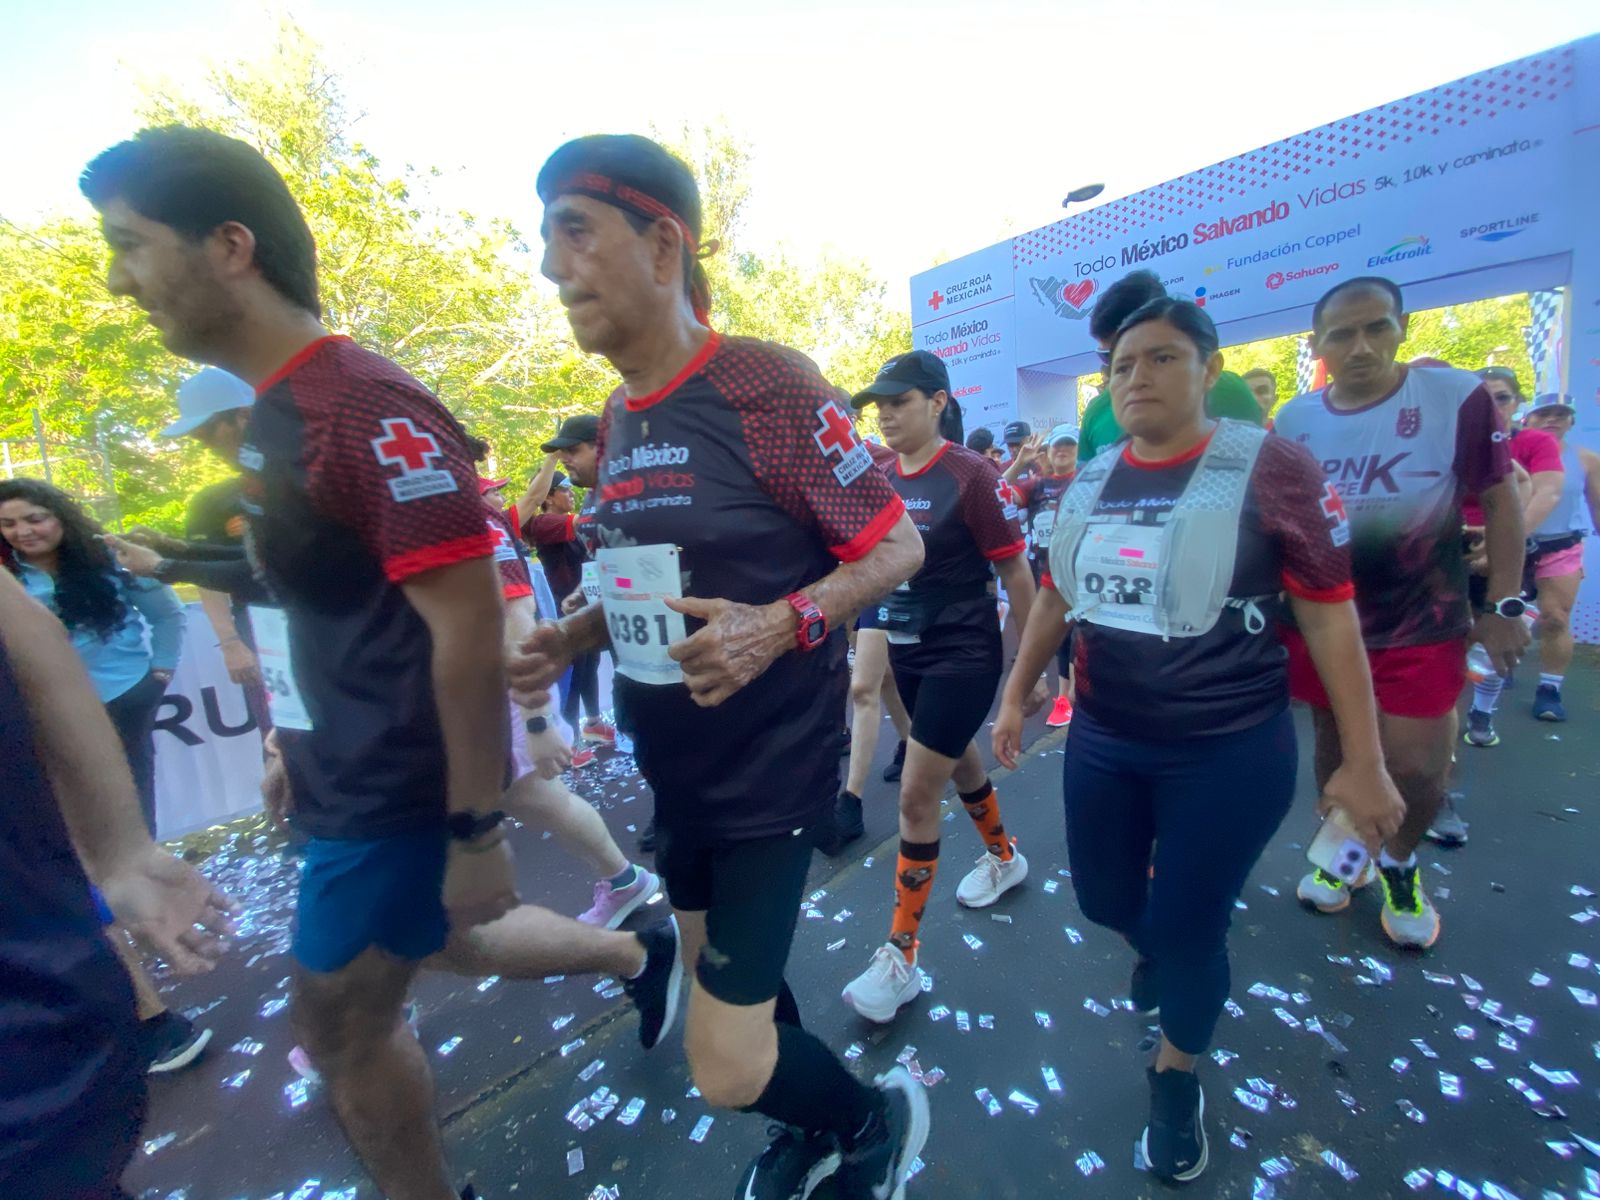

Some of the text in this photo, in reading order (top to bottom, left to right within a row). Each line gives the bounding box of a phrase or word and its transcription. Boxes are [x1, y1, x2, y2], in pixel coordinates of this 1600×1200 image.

[1074, 255, 1116, 277] Todo
[1121, 233, 1189, 267] México
[1193, 200, 1290, 245] Salvando
[1297, 179, 1366, 209] Vidas
[1403, 164, 1433, 185] 10k
[1438, 161, 1447, 175] y
[1453, 138, 1531, 170] caminata
[1459, 212, 1540, 239] SPORTLINE
[1227, 224, 1361, 270] Fundación Coppel
[1367, 244, 1433, 268] Electrolit
[1170, 276, 1184, 285] POR
[1286, 261, 1340, 281] Sahuayo
[946, 273, 992, 295] CRUZ ROJA
[946, 284, 992, 305] MEXICANA
[1209, 288, 1241, 300] IMAGEN
[924, 319, 988, 346] Todo México
[971, 332, 1001, 347] Vidas
[969, 349, 997, 361] caminata
[632, 442, 690, 470] México
[838, 456, 856, 474] CRUZ
[610, 611, 669, 646] 0381
